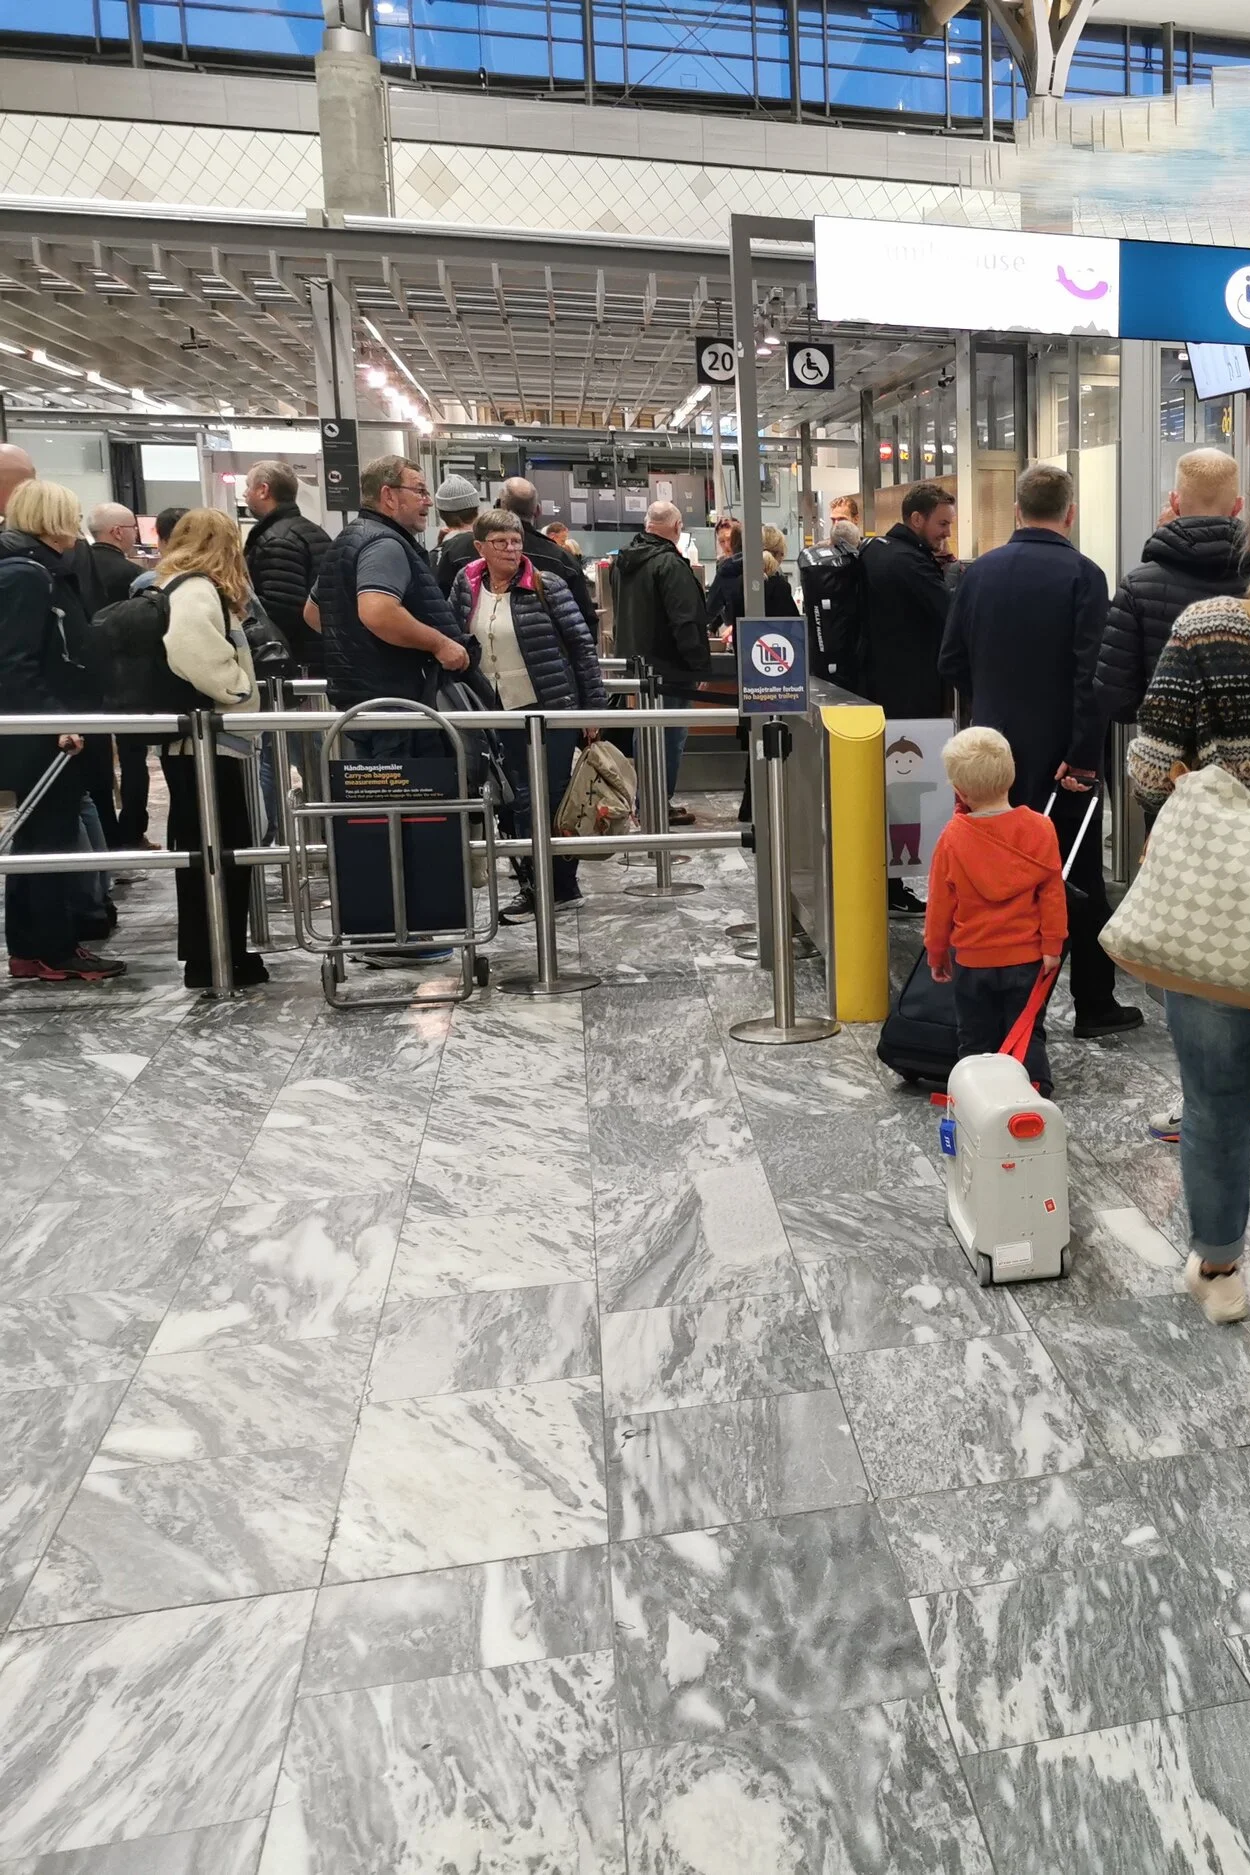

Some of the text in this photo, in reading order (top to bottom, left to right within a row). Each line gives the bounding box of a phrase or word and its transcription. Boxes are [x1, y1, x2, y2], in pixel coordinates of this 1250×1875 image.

[708, 351, 734, 372] 20
[743, 686, 782, 694] Bagasjetraller
[778, 692, 800, 700] trolleys
[344, 763, 403, 772] Håndbagasjemåler
[344, 771, 402, 780] Carry-on baggage
